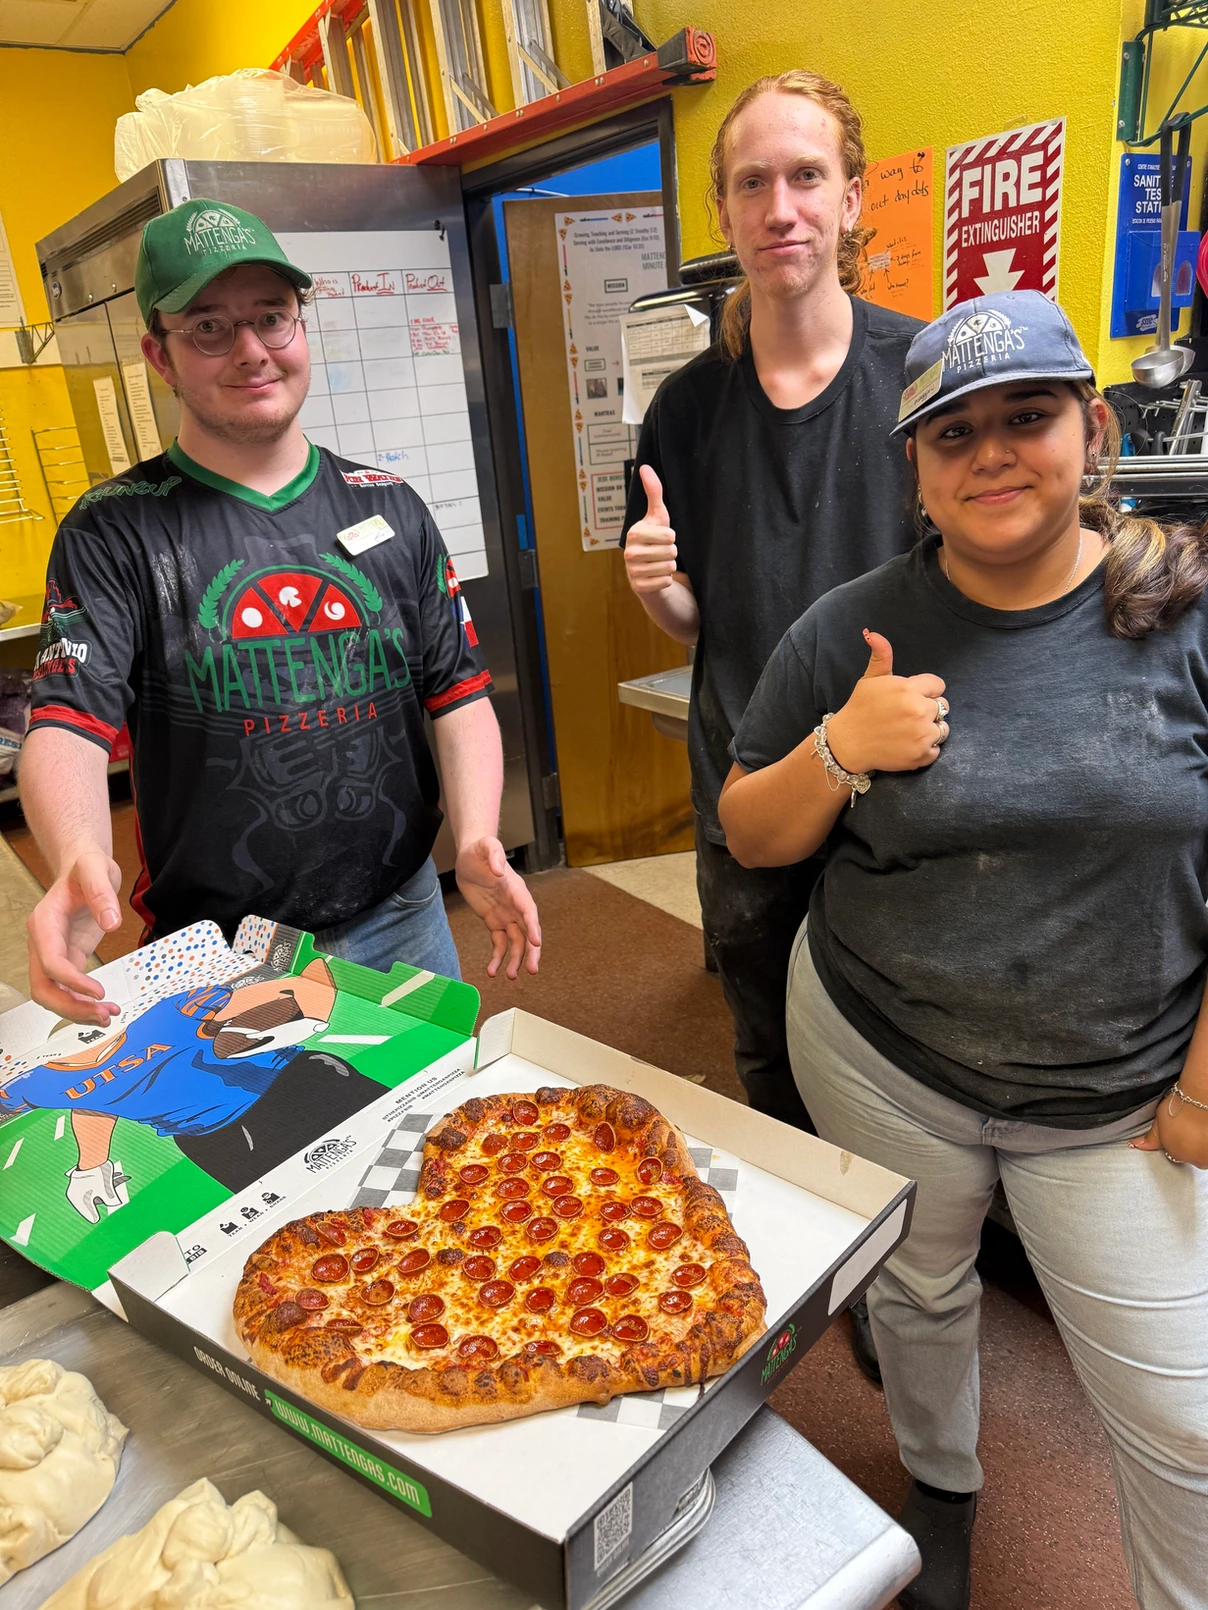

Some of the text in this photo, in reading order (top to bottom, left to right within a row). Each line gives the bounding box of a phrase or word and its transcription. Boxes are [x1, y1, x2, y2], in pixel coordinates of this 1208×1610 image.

[880, 158, 924, 181] way to
[961, 151, 1044, 218] FIRE
[1134, 174, 1161, 188] SANIT
[870, 194, 889, 212] out
[1135, 201, 1162, 214] STATI
[1145, 188, 1162, 200] TES
[184, 227, 256, 255] MATTENGA'S
[961, 210, 1040, 248] EXTINGUISHER
[942, 329, 1024, 372] MATTENGA'S
[956, 352, 1010, 373] PIZZERIA
[185, 628, 412, 714] MATTENGA'S
[243, 702, 378, 736] PIZZERIA
[61, 1043, 174, 1100] UTSA
[396, 1083, 427, 1104] MENTION
[306, 1140, 357, 1173] MATTENGA'S
[184, 1244, 200, 1255] TO
[193, 1346, 261, 1401] ORDER ONLINE
[274, 1400, 420, 1505] WWW.MATTENGAS.COM
